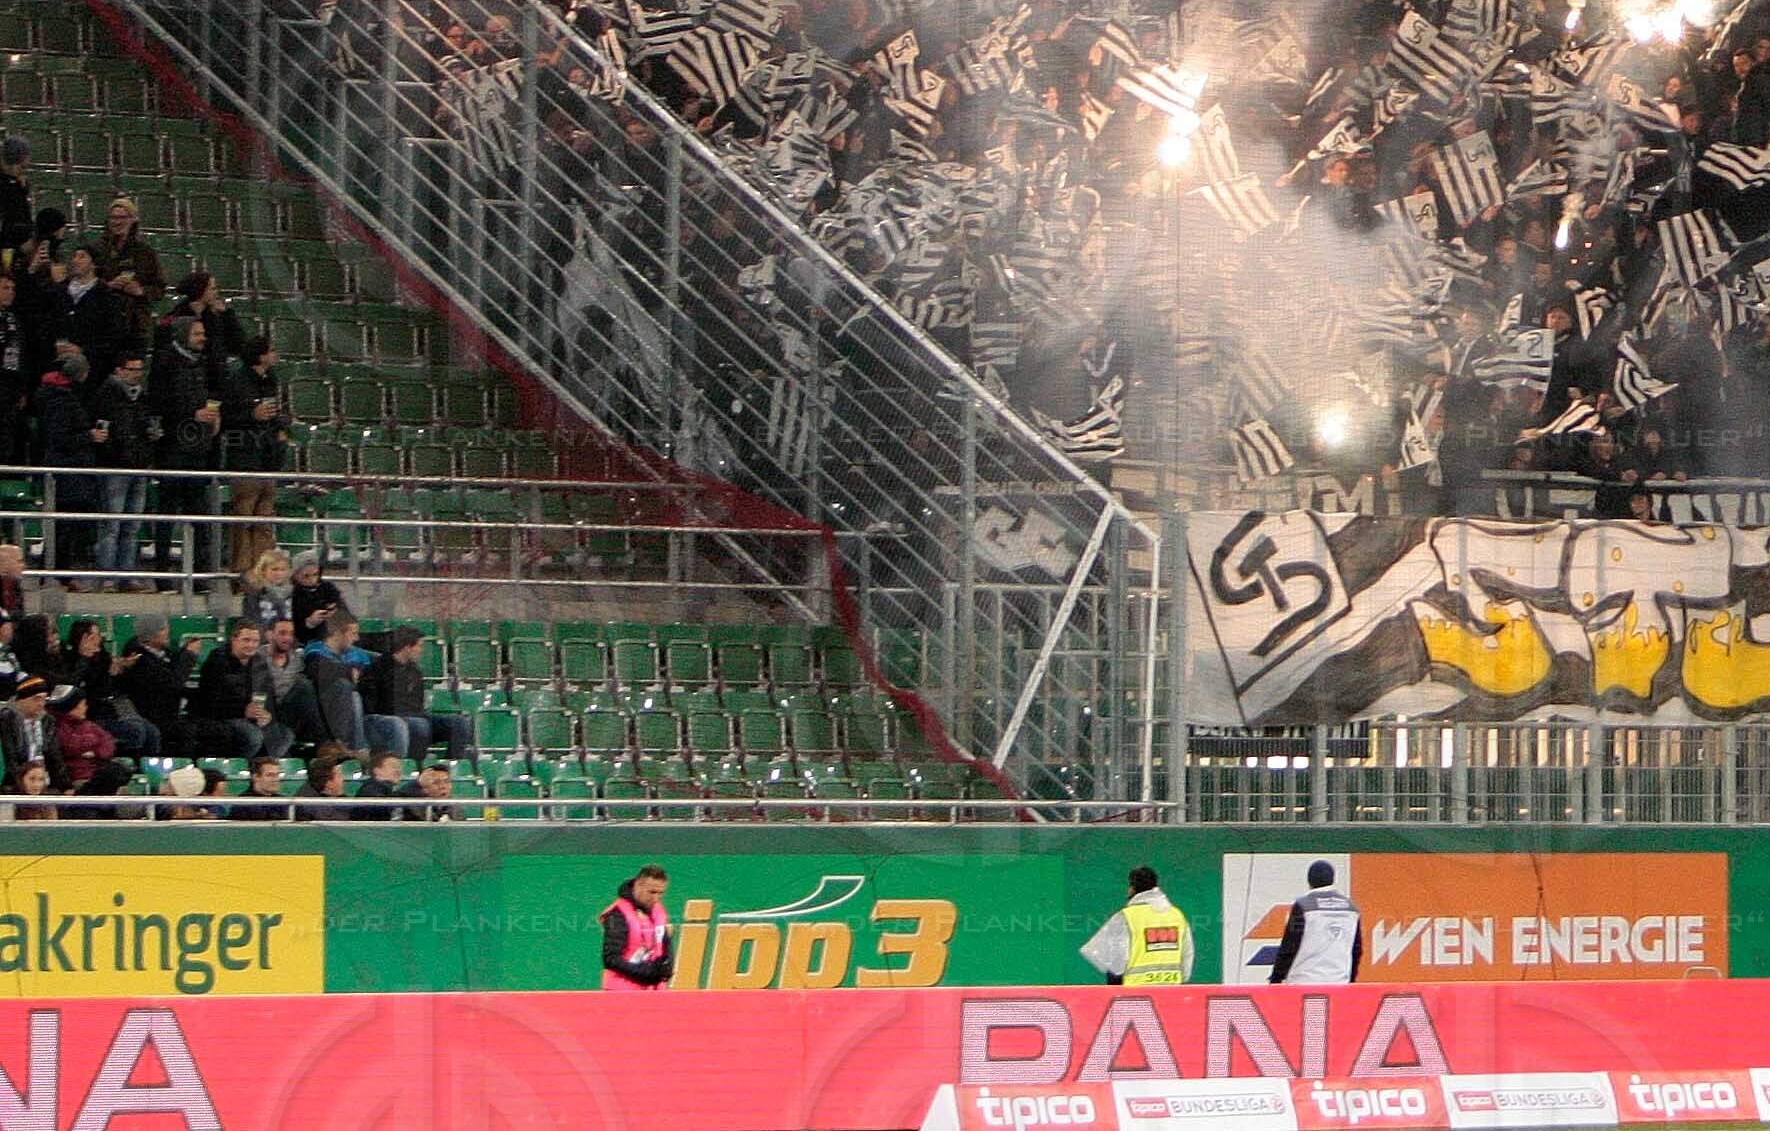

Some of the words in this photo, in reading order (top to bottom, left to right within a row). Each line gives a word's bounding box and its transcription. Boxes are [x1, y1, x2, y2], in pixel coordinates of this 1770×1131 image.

[0, 892, 283, 995] akringer
[668, 898, 958, 990] ipp3
[1371, 916, 1494, 965] WIEN
[1512, 915, 1705, 965] ENERGIE
[959, 993, 1453, 1082] PANA
[977, 1087, 1093, 1130] tipico
[1312, 1080, 1426, 1123] tipico
[1628, 1074, 1737, 1117] tipico
